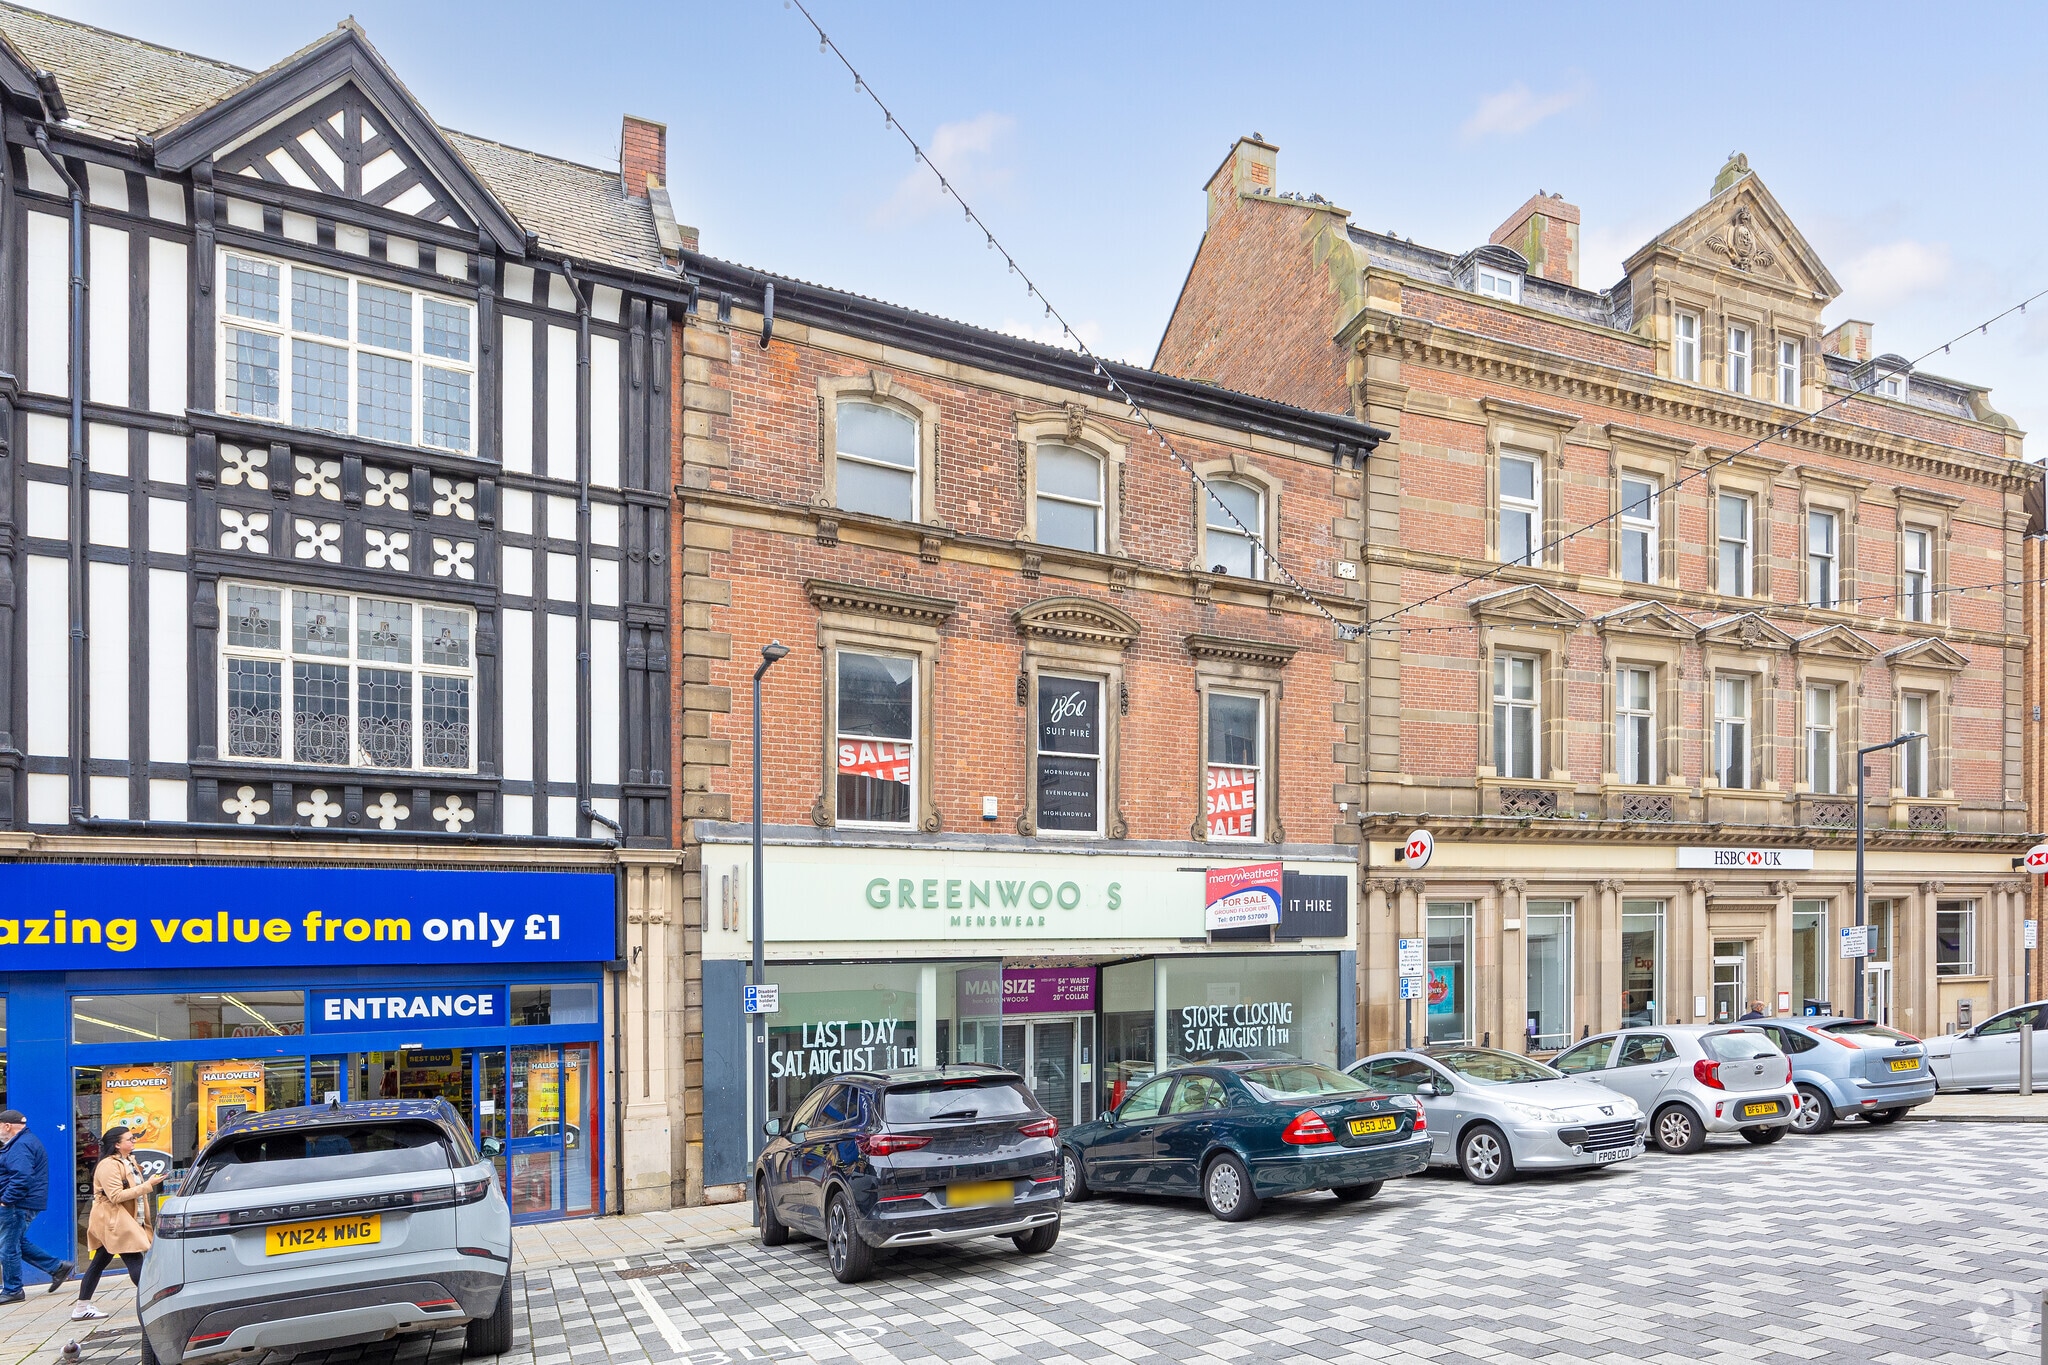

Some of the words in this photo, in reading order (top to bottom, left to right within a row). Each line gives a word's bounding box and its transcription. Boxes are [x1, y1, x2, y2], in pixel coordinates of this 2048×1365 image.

[1046, 726, 1066, 736] SUIT
[1069, 728, 1090, 738] HIRE
[839, 742, 910, 767] SALE
[1044, 769, 1091, 777] MORNINGWEAR
[1207, 768, 1255, 791] SALE
[1045, 789, 1089, 797] EVENINGWEAR
[1206, 789, 1254, 815] SALE
[1042, 810, 1092, 818] HIGHLANDWEAR
[1714, 850, 1745, 865] HSBC
[1764, 851, 1782, 865] UK
[1209, 867, 1279, 885] merryweathers
[1222, 897, 1241, 908] FOR
[1243, 894, 1267, 905] SALE
[1305, 899, 1333, 912] HIRE
[1214, 908, 1238, 916] GROUND
[1239, 906, 1258, 914] FLOOR
[1229, 914, 1246, 922] 01709
[1247, 912, 1268, 921] 537009
[950, 915, 1046, 928] MENSWEAR
[150, 911, 292, 943] value
[303, 910, 411, 943] from
[422, 911, 515, 948] only
[524, 914, 561, 941] £1
[747, 987, 756, 998] P
[965, 979, 1036, 995] MANSIZE
[324, 994, 494, 1021] ENTRANCE
[1182, 1004, 1229, 1028] STORE
[1233, 1001, 1293, 1026] CLOSING
[802, 1020, 849, 1049] LAST
[861, 1017, 898, 1046] DAY
[1217, 1026, 1264, 1049] AUGUST
[409, 1055, 425, 1063] BEST
[429, 1054, 451, 1062] BUYS
[809, 1046, 875, 1075] AUGUST
[203, 1071, 261, 1081] HALLOWEEN
[106, 1078, 167, 1089] HALLOWEEN
[1747, 1104, 1763, 1115] BF67
[1763, 1103, 1776, 1113] BNK
[1353, 1121, 1376, 1133] LP53
[1377, 1118, 1392, 1130] JCP
[1598, 1150, 1617, 1162] FP09
[238, 1203, 317, 1219] RANGE
[331, 1193, 406, 1209] ROVER
[276, 1226, 328, 1248] YN24
[333, 1221, 372, 1242] WWG
[191, 1246, 227, 1254] VELAR
